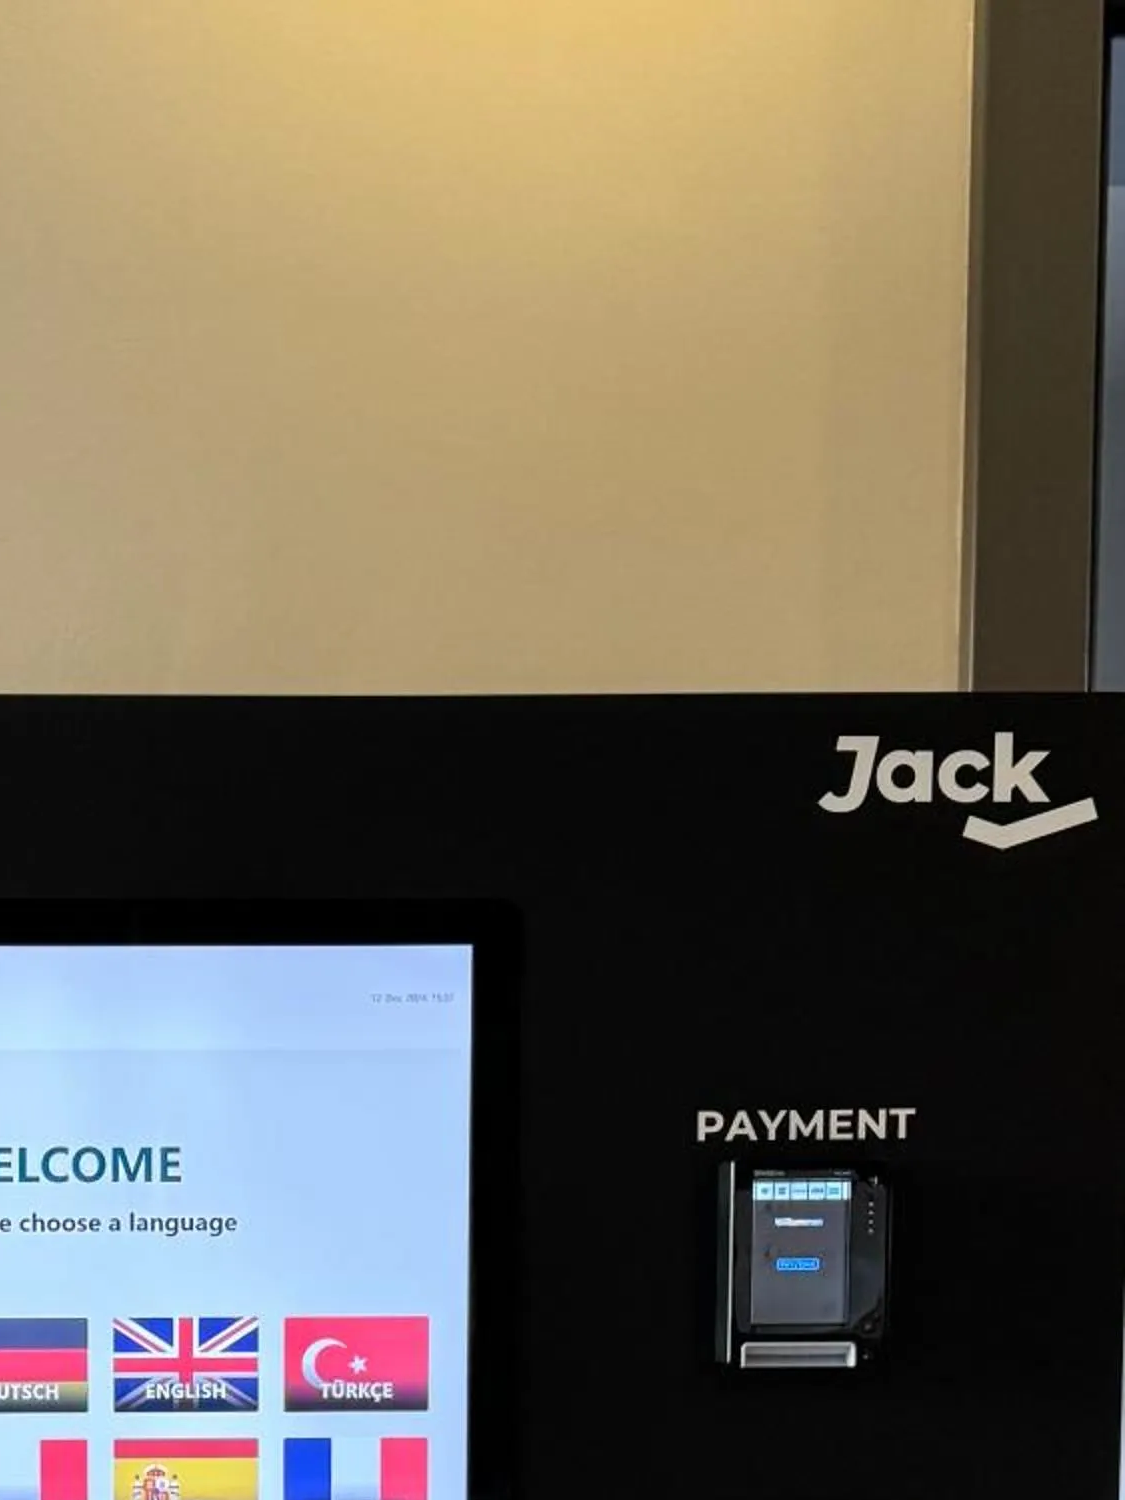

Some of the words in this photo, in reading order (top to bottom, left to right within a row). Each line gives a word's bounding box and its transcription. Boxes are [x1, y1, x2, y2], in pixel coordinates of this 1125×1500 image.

[818, 732, 1050, 812] Jack
[697, 1108, 916, 1141] PAYMENT
[20, 1213, 101, 1232] choose
[109, 1218, 120, 1231] a
[130, 1212, 237, 1237] language
[145, 1383, 226, 1399] ENGLISH
[321, 1380, 394, 1401] TÜRKÇE
